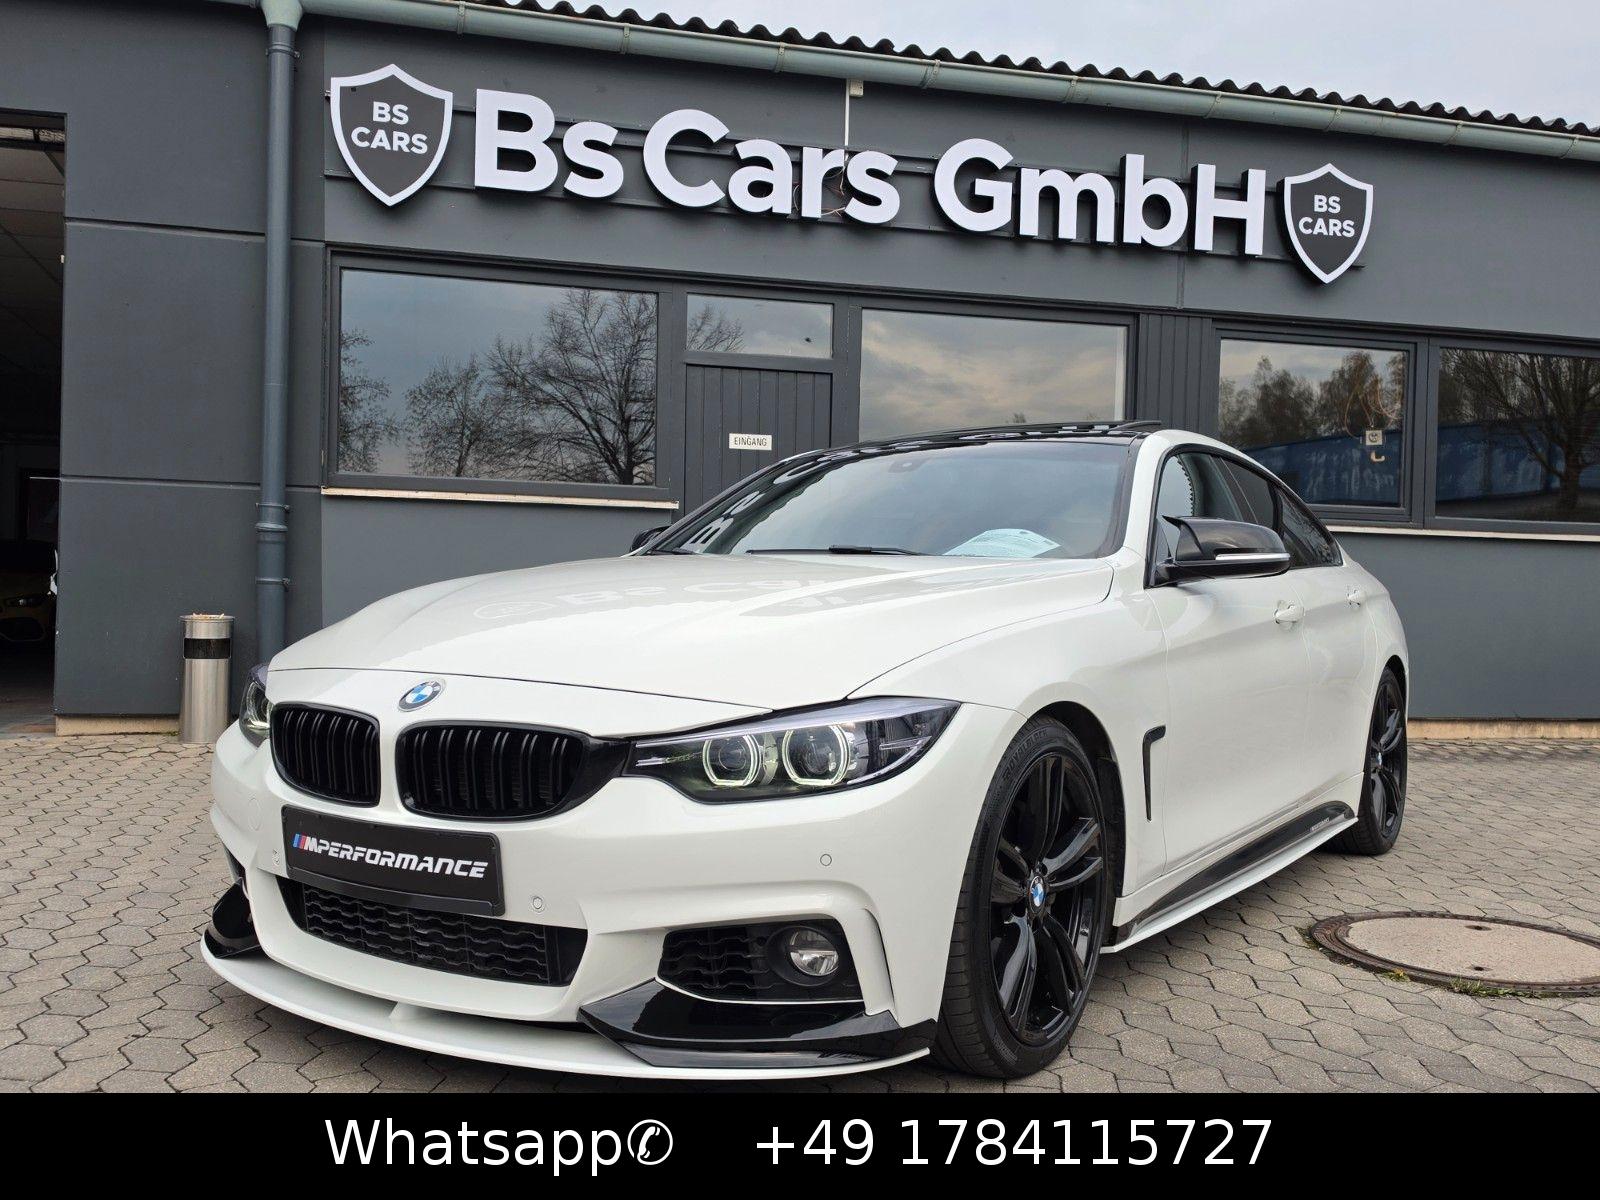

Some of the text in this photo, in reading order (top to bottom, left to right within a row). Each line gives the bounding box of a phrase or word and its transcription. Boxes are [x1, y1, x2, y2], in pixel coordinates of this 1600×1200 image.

[372, 101, 409, 125] BS
[350, 126, 428, 155] CARS
[474, 88, 1267, 256] Bs Cars GmbH
[1313, 194, 1341, 214] BS
[1298, 216, 1355, 238] CARS
[733, 436, 768, 447] EINGANG
